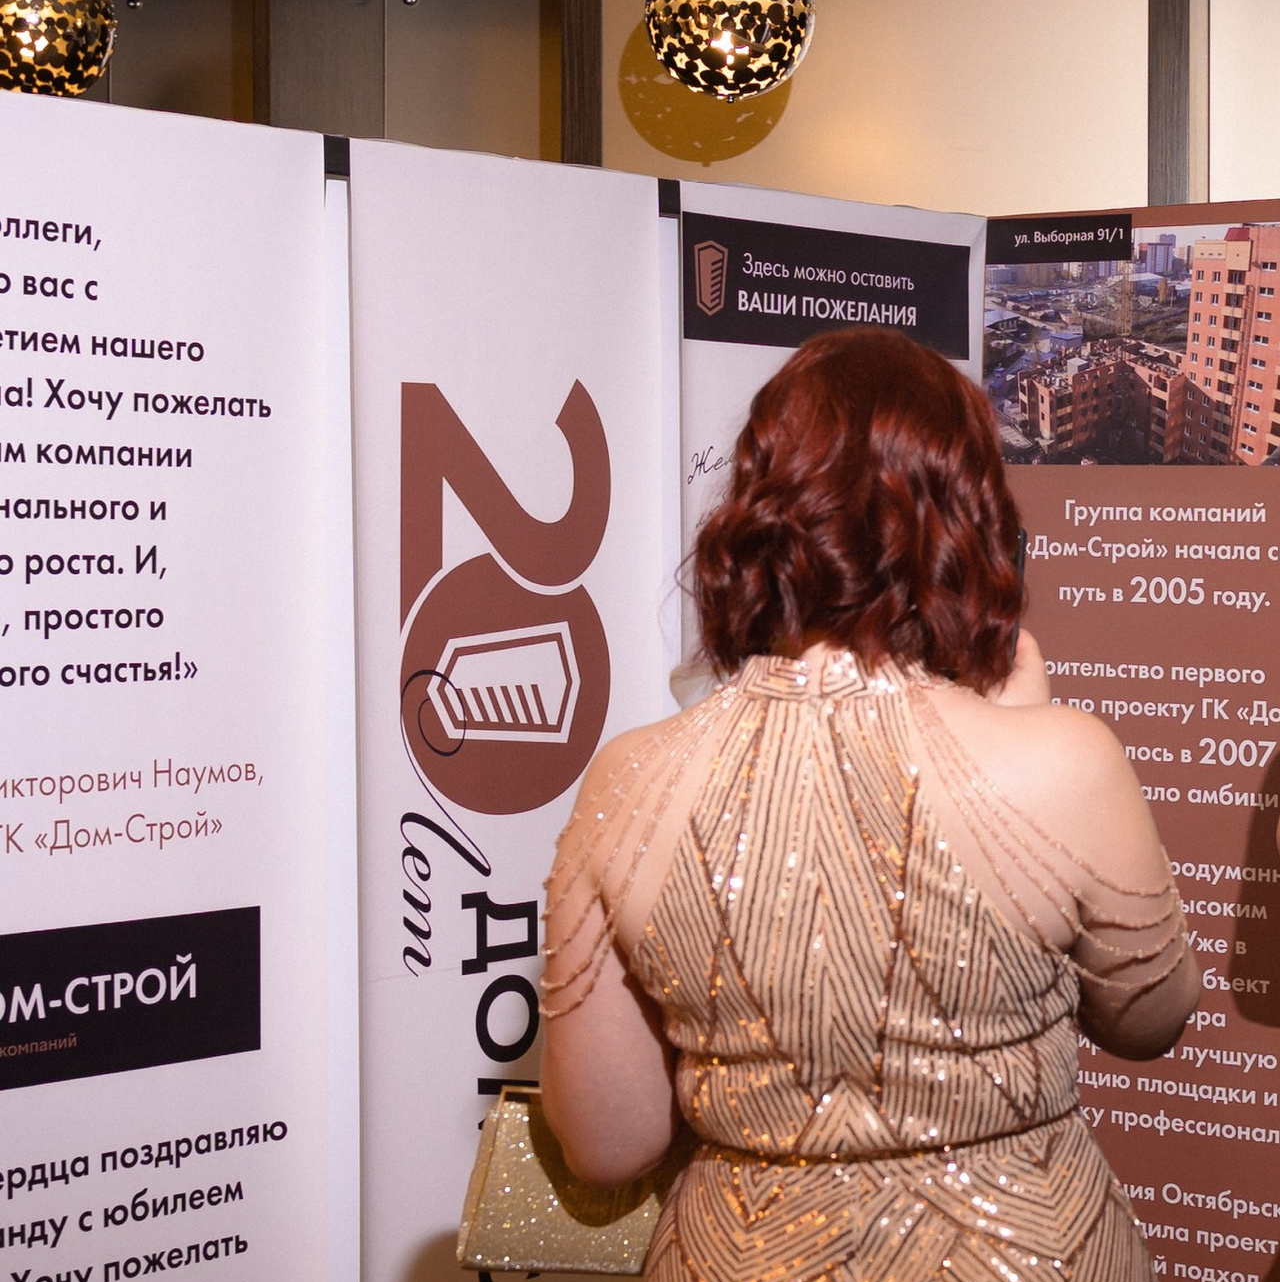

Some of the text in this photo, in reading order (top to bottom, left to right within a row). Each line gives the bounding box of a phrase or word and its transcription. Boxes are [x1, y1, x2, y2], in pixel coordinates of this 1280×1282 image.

[0, 217, 101, 251] ллеги,
[1014, 227, 1124, 247] ул. Выборная 91/1
[23, 274, 74, 299] вас
[84, 279, 98, 301] с
[742, 252, 915, 291] Здесь можно оставить
[737, 289, 917, 327] ВАШИ ПОЖЕЛАНИЯ
[0, 329, 205, 362] тием нашего
[0, 377, 272, 420] а! Хочу пожелать
[37, 443, 192, 467] компании
[150, 501, 167, 521] и
[1064, 499, 1266, 526] Группа компаний
[25, 554, 124, 584] роста.
[136, 545, 167, 580] И,
[1175, 544, 1260, 561] начала
[1058, 576, 1270, 613] путь в 2005 году.
[25, 607, 164, 640] простого
[61, 651, 198, 685] счастья!»
[1171, 666, 1266, 688] первого
[1101, 700, 1195, 724] проекту
[1202, 698, 1229, 720] ГК
[1181, 749, 1192, 764] в
[1199, 737, 1277, 768] 2007
[153, 758, 263, 794] Наумов,
[35, 811, 222, 856] «Дом-Строй»
[1236, 941, 1247, 955] в
[0, 952, 197, 1023] М-СТРОЙ
[1181, 1045, 1278, 1072] лучшую
[1137, 1077, 1256, 1104] площадки
[1263, 1091, 1278, 1107] и
[0, 1121, 288, 1200] рдца поздравляю
[0, 1181, 244, 1248] нду с юбилеем
[103, 1234, 249, 1282] пожелать
[1196, 1230, 1279, 1254] проект
